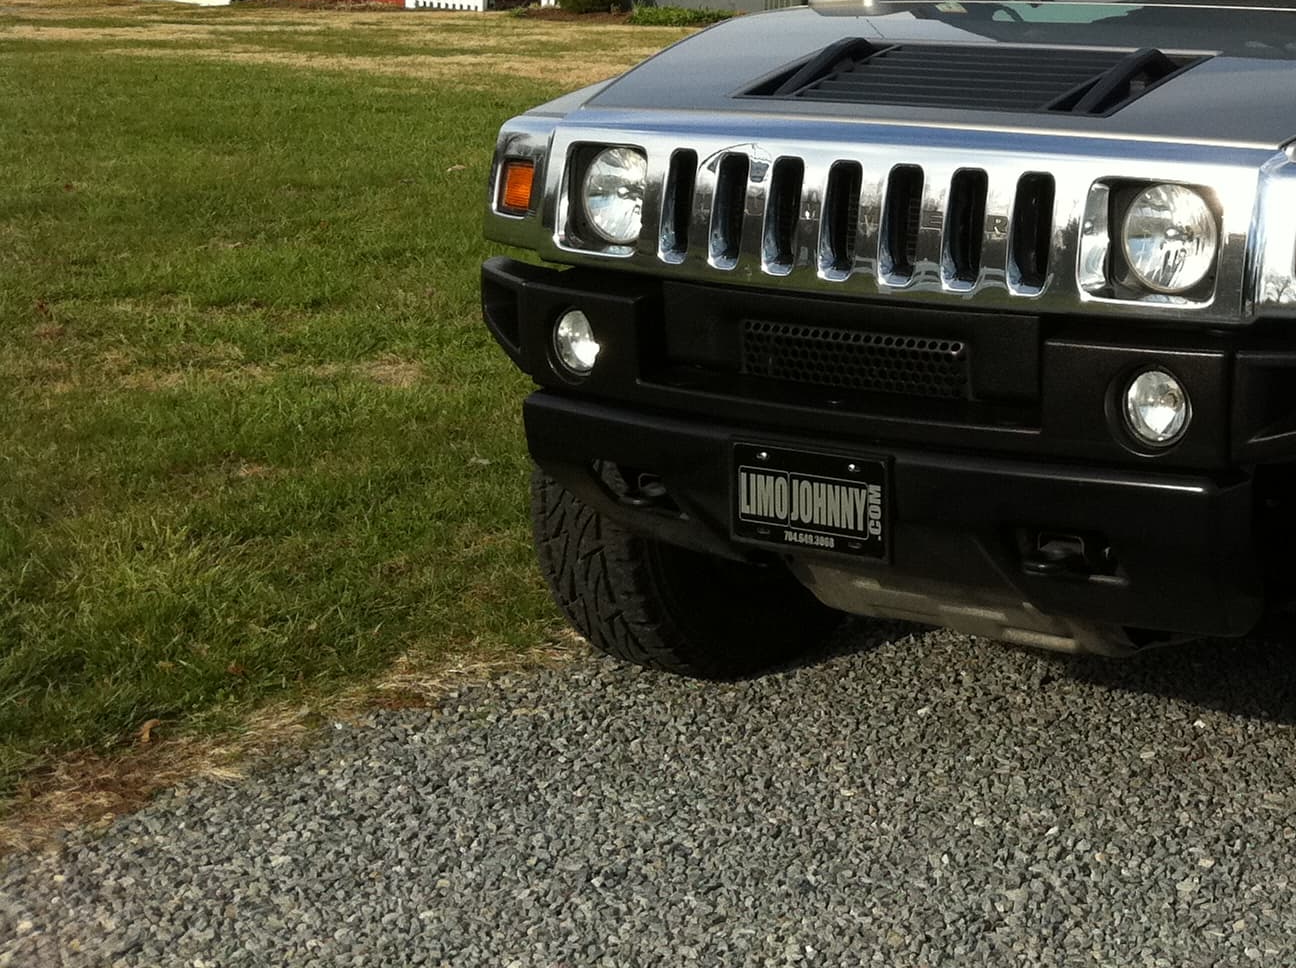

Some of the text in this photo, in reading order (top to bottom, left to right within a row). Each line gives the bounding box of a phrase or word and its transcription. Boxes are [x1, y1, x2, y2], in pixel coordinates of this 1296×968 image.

[740, 472, 867, 532] LIMO JOHNNY
[868, 484, 882, 542] .COM
